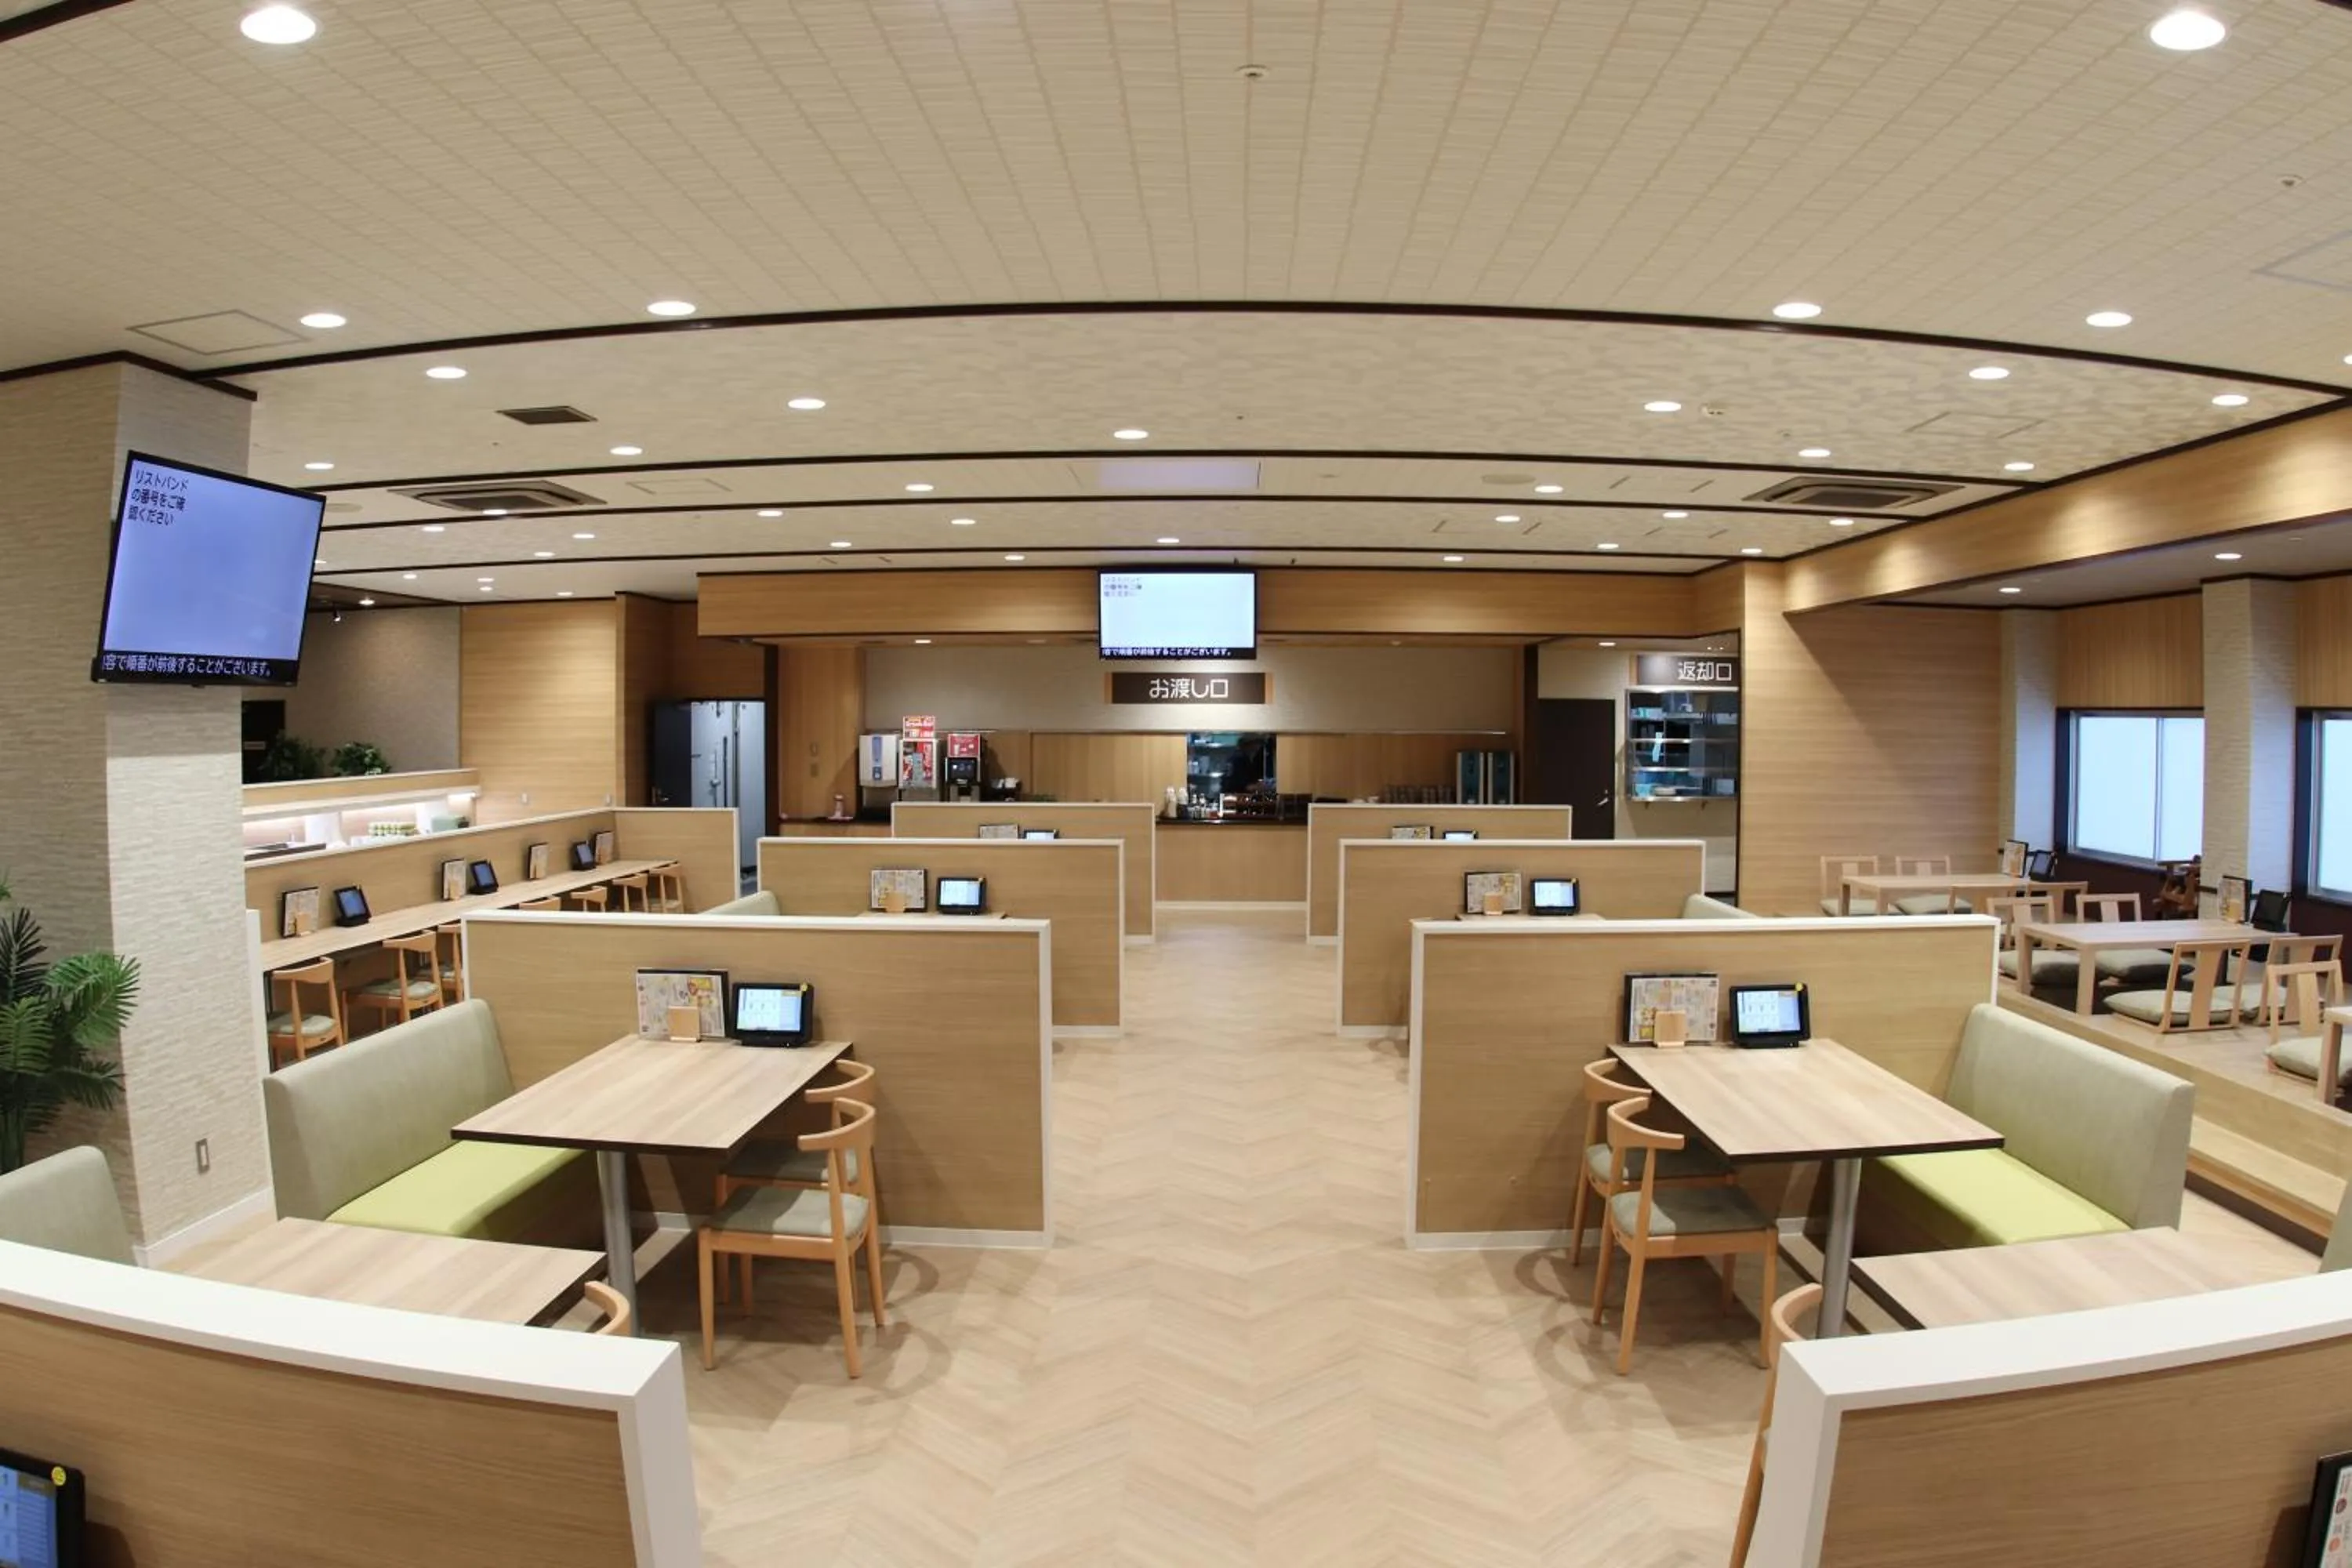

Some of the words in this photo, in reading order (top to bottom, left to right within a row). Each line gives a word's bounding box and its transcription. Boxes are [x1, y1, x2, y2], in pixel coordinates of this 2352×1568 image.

[136, 470, 189, 492] リストバンド
[1678, 661, 1732, 681] 返却口
[1149, 678, 1229, 699] お渡し口
